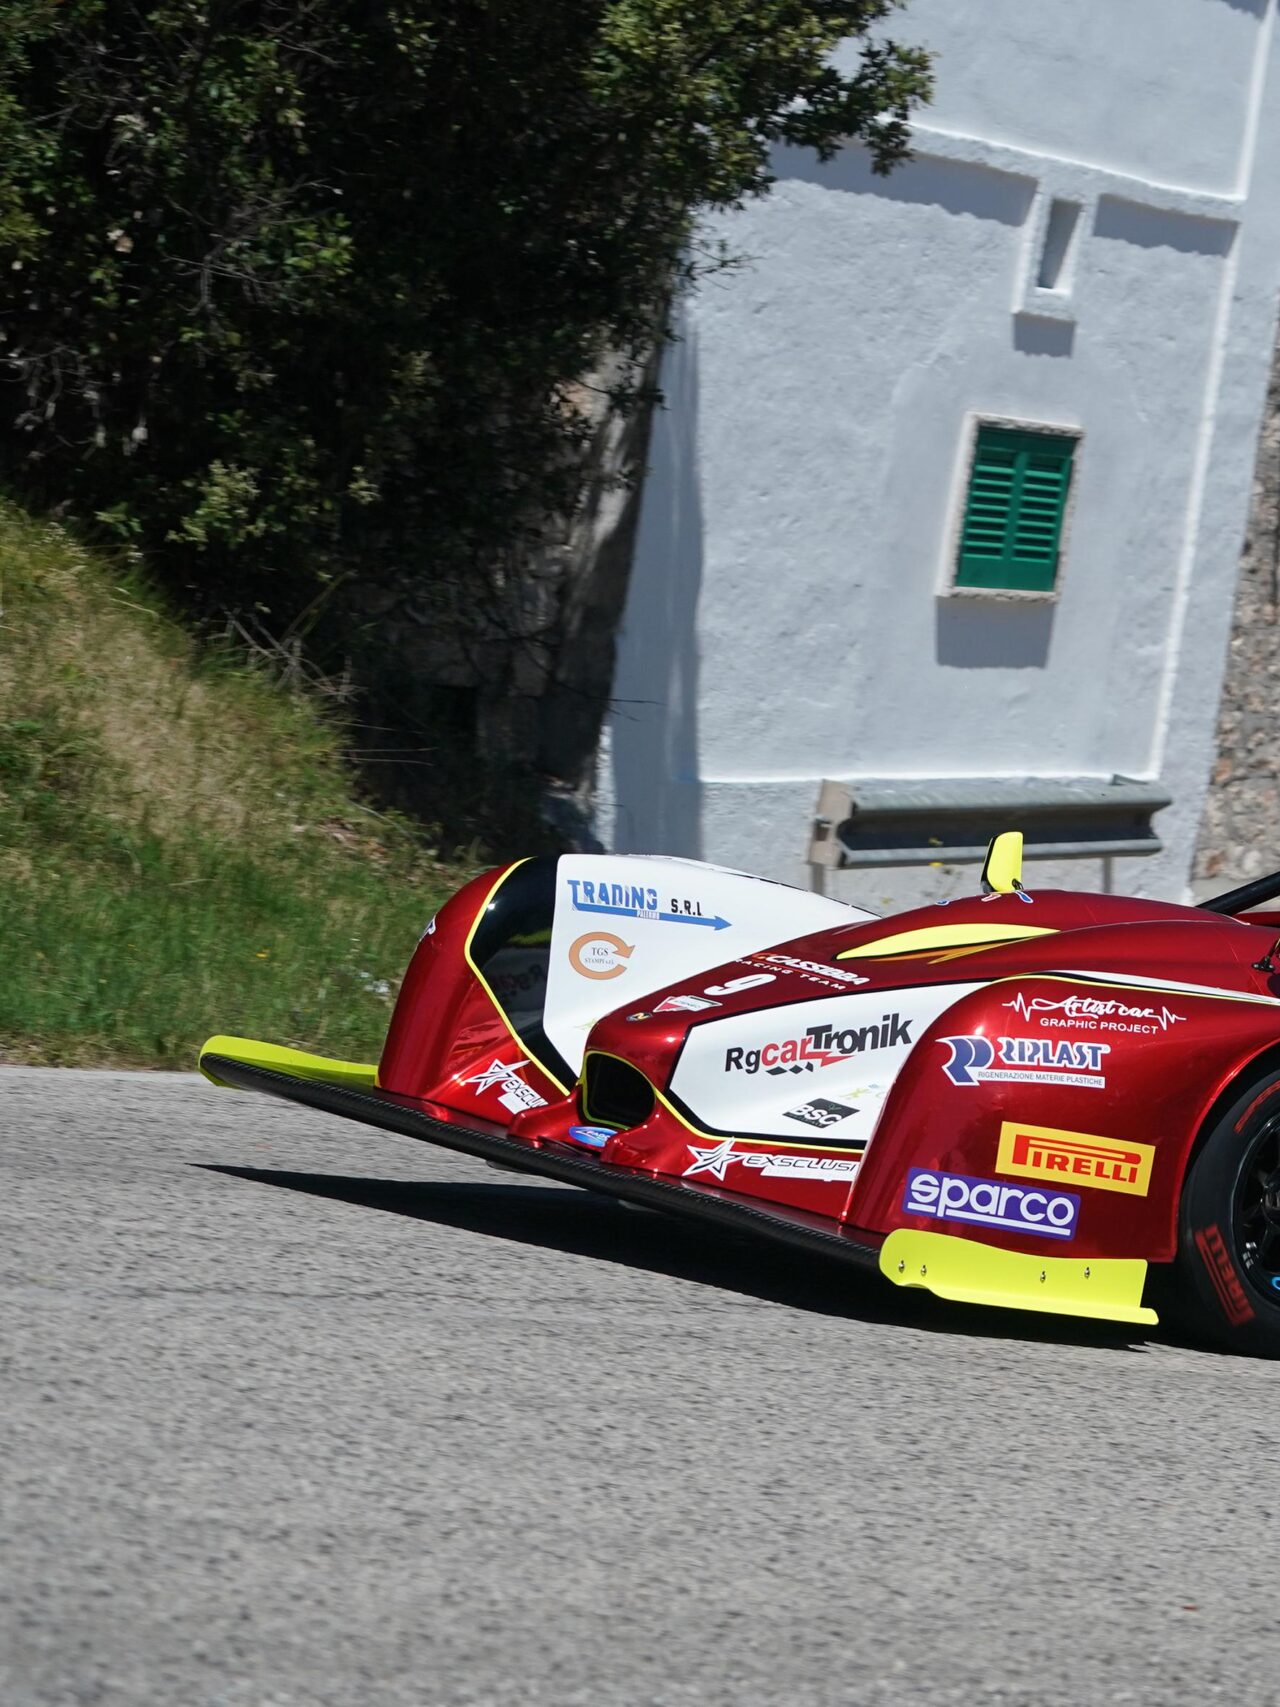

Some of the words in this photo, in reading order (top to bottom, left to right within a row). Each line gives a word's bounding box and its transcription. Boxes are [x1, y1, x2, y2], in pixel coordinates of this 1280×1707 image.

[567, 880, 658, 911] TRADING
[592, 947, 609, 957] TGS
[704, 973, 777, 996] 9
[800, 973, 846, 990] TEAM
[1117, 1003, 1153, 1018] car
[1040, 1017, 1097, 1030] GRAPHIC
[1100, 1021, 1159, 1035] PROJECT
[978, 1071, 1034, 1081] RIGENERAZIONE
[1036, 1073, 1066, 1083] MATERIE
[1066, 1076, 1103, 1086] PLASTICHE
[792, 1104, 843, 1126] BSC
[746, 1155, 856, 1172] EXSCLUSI
[1011, 1134, 1143, 1184] PIRELLI
[909, 1172, 1076, 1227] sparco
